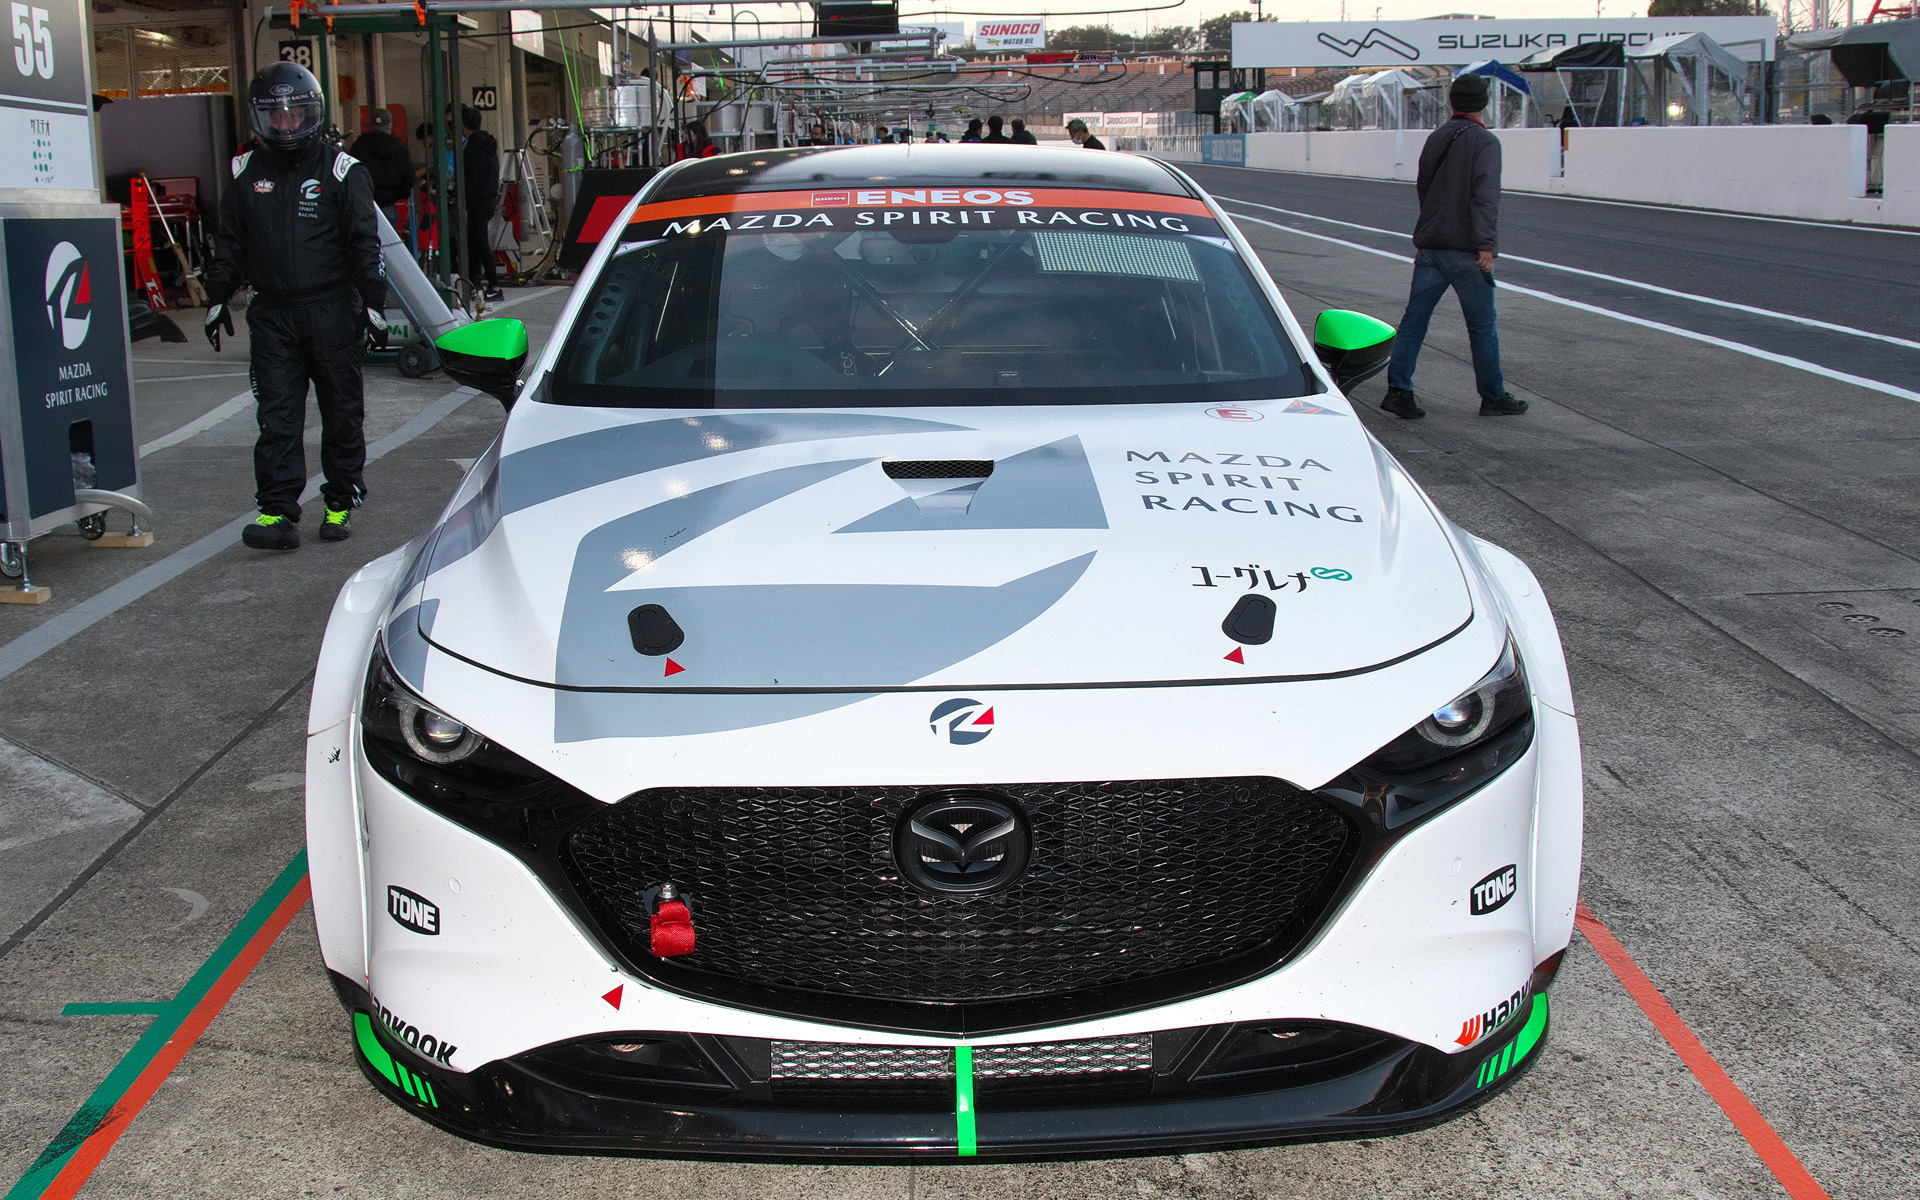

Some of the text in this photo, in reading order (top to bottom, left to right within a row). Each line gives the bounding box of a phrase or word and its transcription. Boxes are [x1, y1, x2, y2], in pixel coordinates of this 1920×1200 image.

[11, 2, 54, 80] 55
[980, 23, 1040, 36] SUNOCO
[1438, 32, 1696, 48] SUZUKA CIRC
[474, 90, 495, 107] 40
[857, 190, 1035, 206] ENEOS
[662, 210, 1190, 237] MAZDA SPIRIT RACING
[58, 362, 92, 381] MAZDA
[45, 382, 108, 409] SPIRIT RACING
[1126, 450, 1333, 472] MAZDA
[1135, 471, 1302, 491] SPIRIT
[1141, 495, 1364, 523] RACING
[1191, 564, 1311, 593] ユーグレナ
[1474, 867, 1515, 911] TONE
[390, 888, 437, 932] TONE
